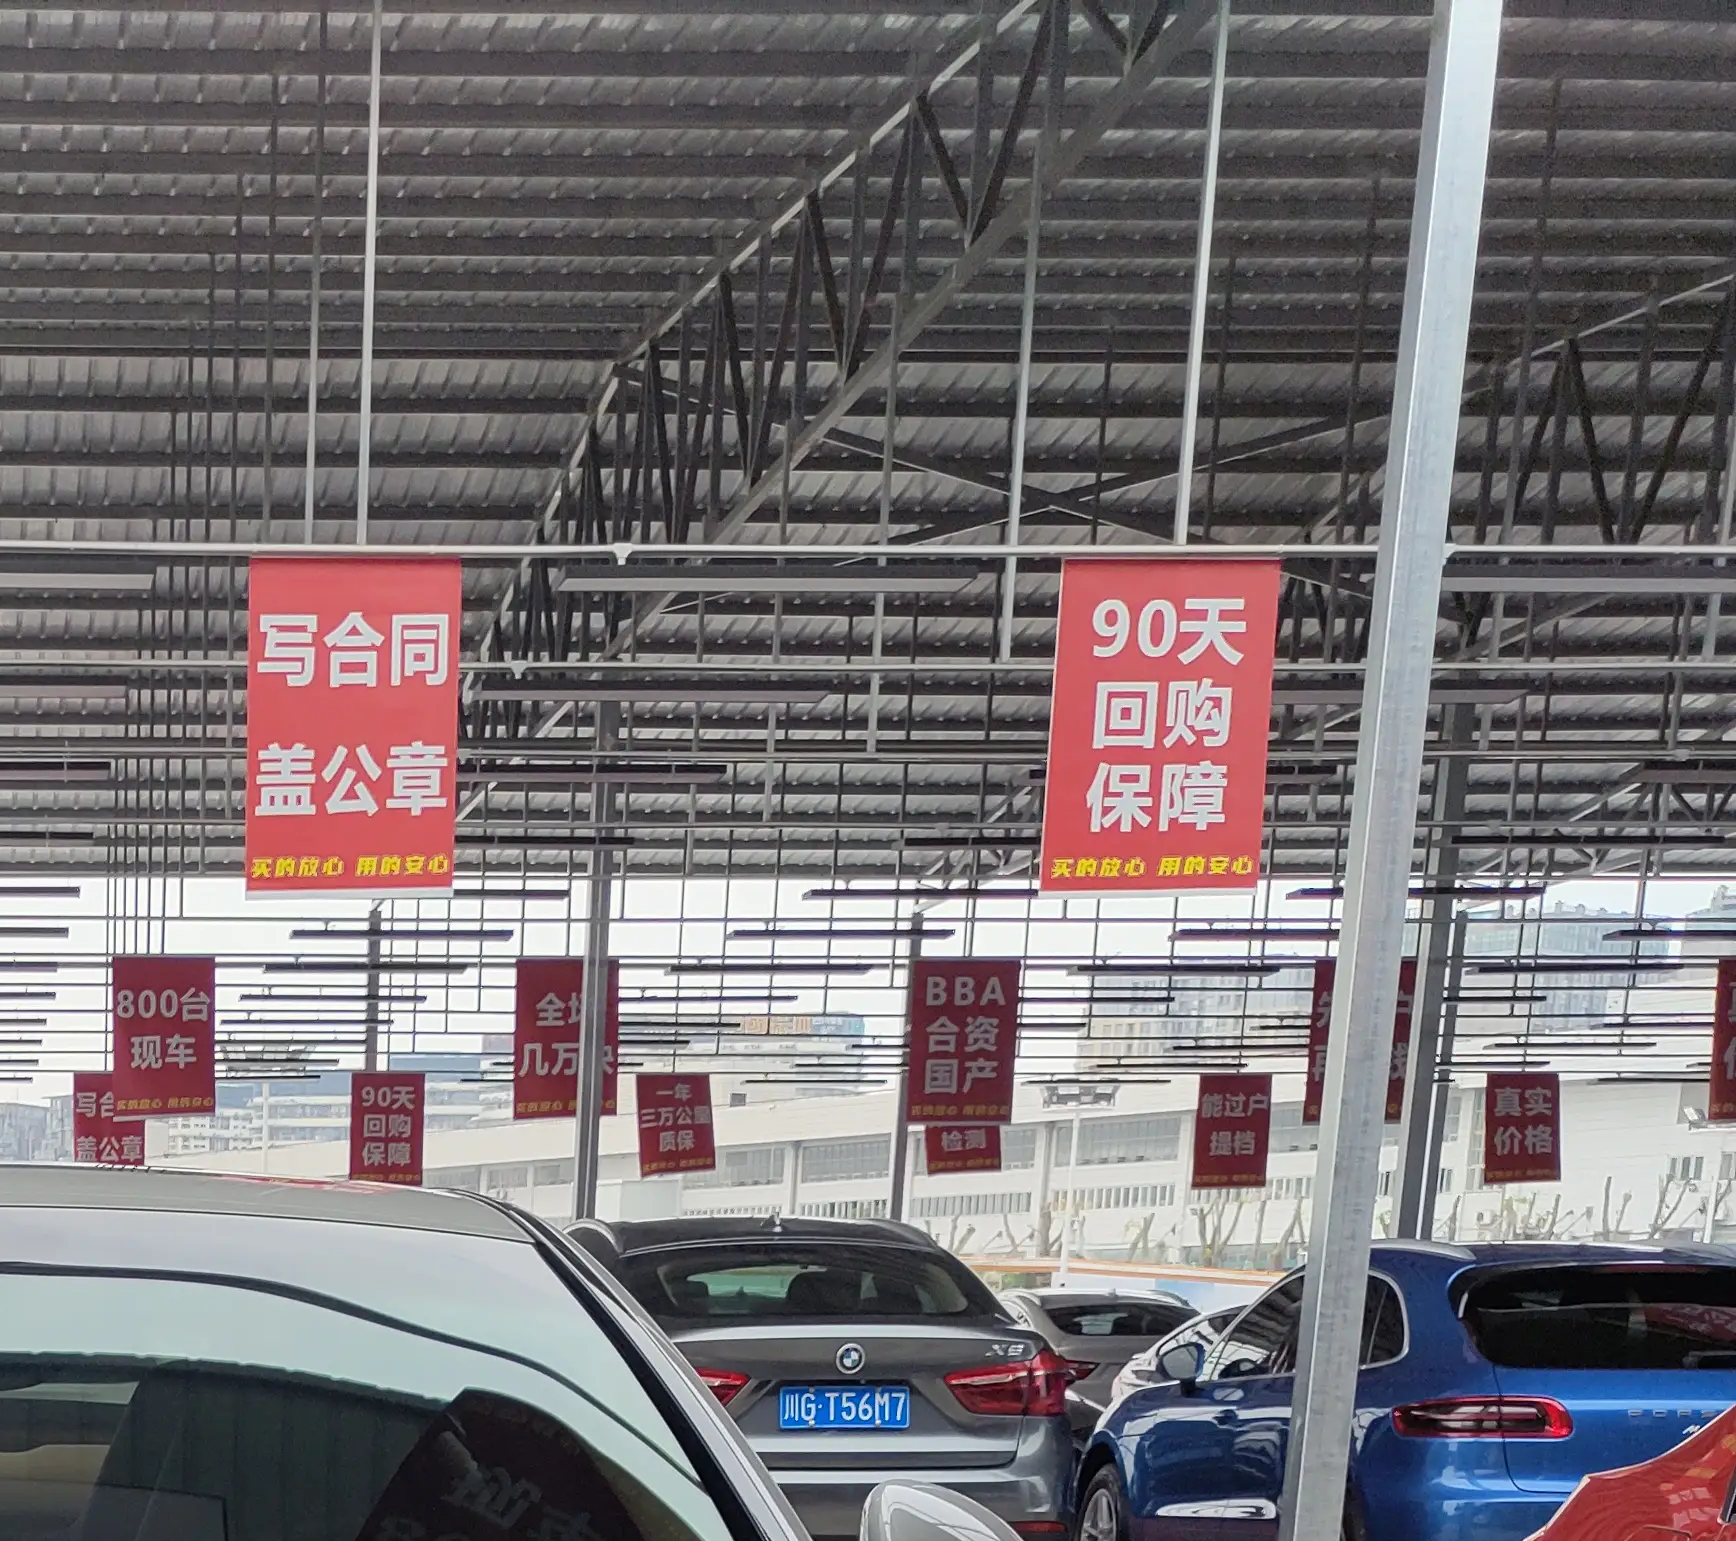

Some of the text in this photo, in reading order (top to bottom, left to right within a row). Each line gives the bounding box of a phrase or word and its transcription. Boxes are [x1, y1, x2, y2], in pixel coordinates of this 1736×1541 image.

[1092, 598, 1246, 665] 90天
[257, 612, 449, 687] 写合同
[1092, 678, 1232, 749] 回购
[255, 741, 448, 816] 盖公章
[1086, 761, 1228, 832] 保障
[251, 853, 449, 879] 买的放心 用的安心
[1051, 856, 1253, 879] 买的放心 用的安心
[117, 988, 211, 1022] 800台
[926, 976, 1006, 1006] BBA
[926, 1016, 999, 1053] 合资
[131, 1033, 197, 1070] 现车
[924, 1058, 999, 1094] 国产
[361, 1086, 416, 1110] 90天
[1202, 1093, 1268, 1118] 能过户
[1494, 1087, 1552, 1117] 真实
[363, 1113, 411, 1138] 回购
[1494, 1124, 1553, 1156] 价格
[75, 1135, 142, 1162] 盖公章
[362, 1141, 411, 1167] 保障
[784, 1392, 906, 1421] 川G·T56M7
